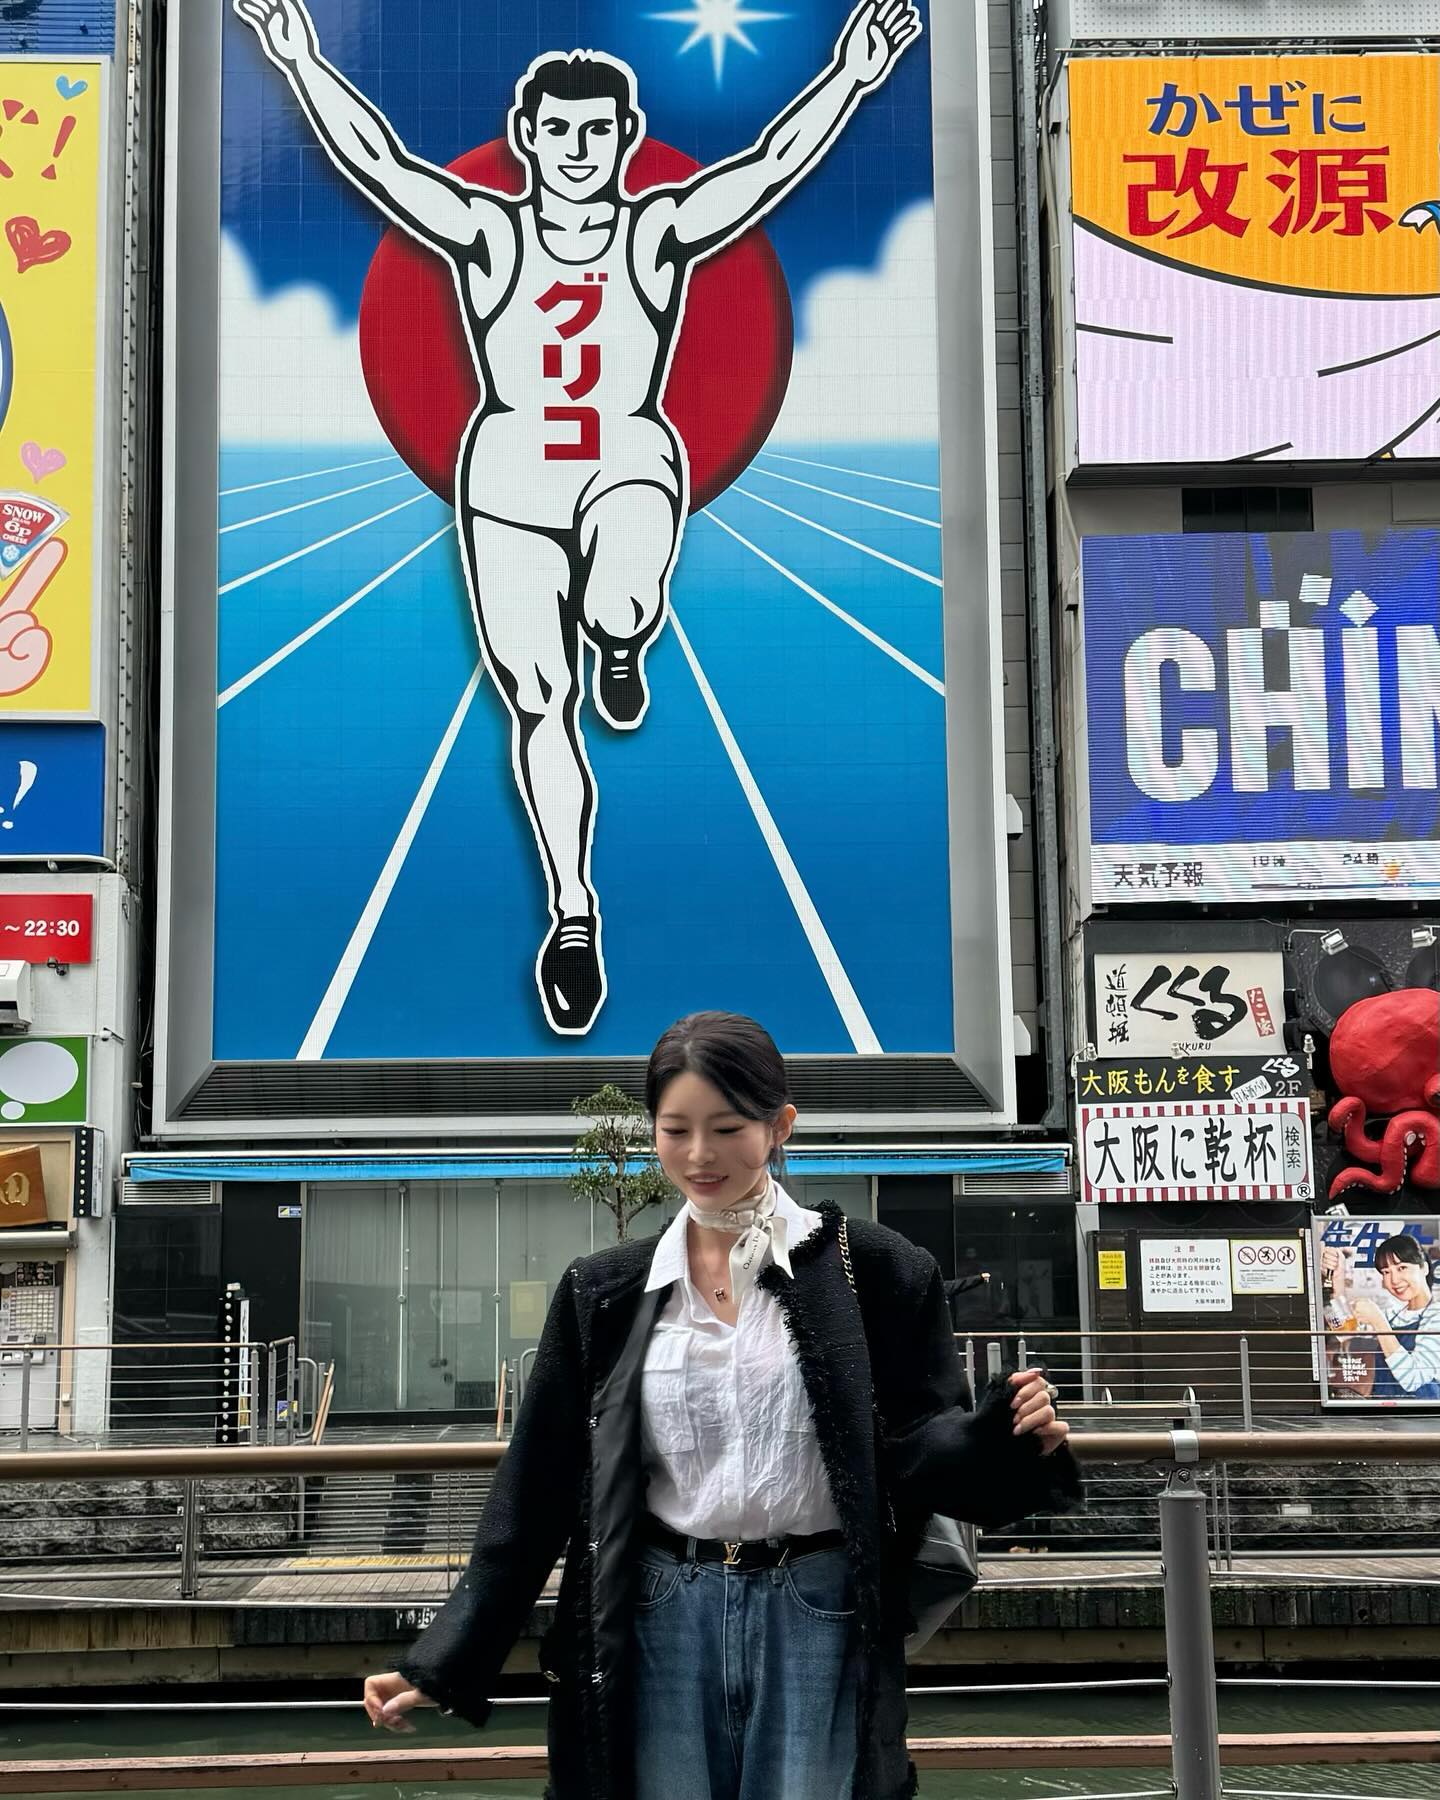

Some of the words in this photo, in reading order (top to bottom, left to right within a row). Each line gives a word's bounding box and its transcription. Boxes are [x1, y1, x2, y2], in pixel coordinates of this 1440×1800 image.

[1146, 80, 1366, 137] かぜに
[1122, 145, 1395, 239] 改源
[533, 272, 609, 460] グリコ
[2, 503, 46, 524] SNOW
[1113, 862, 1204, 888] 天気予報
[1104, 963, 1130, 1046] 道頓堀
[1129, 965, 1249, 1041] くくる
[1177, 1042, 1212, 1051] UKURU
[1261, 1056, 1300, 1078] くくる
[1081, 1064, 1241, 1097] 大阪もんを食す
[1275, 1080, 1302, 1097] 2F
[1093, 1117, 1277, 1185] 大阪に乾杯
[1284, 1126, 1302, 1169] 検索
